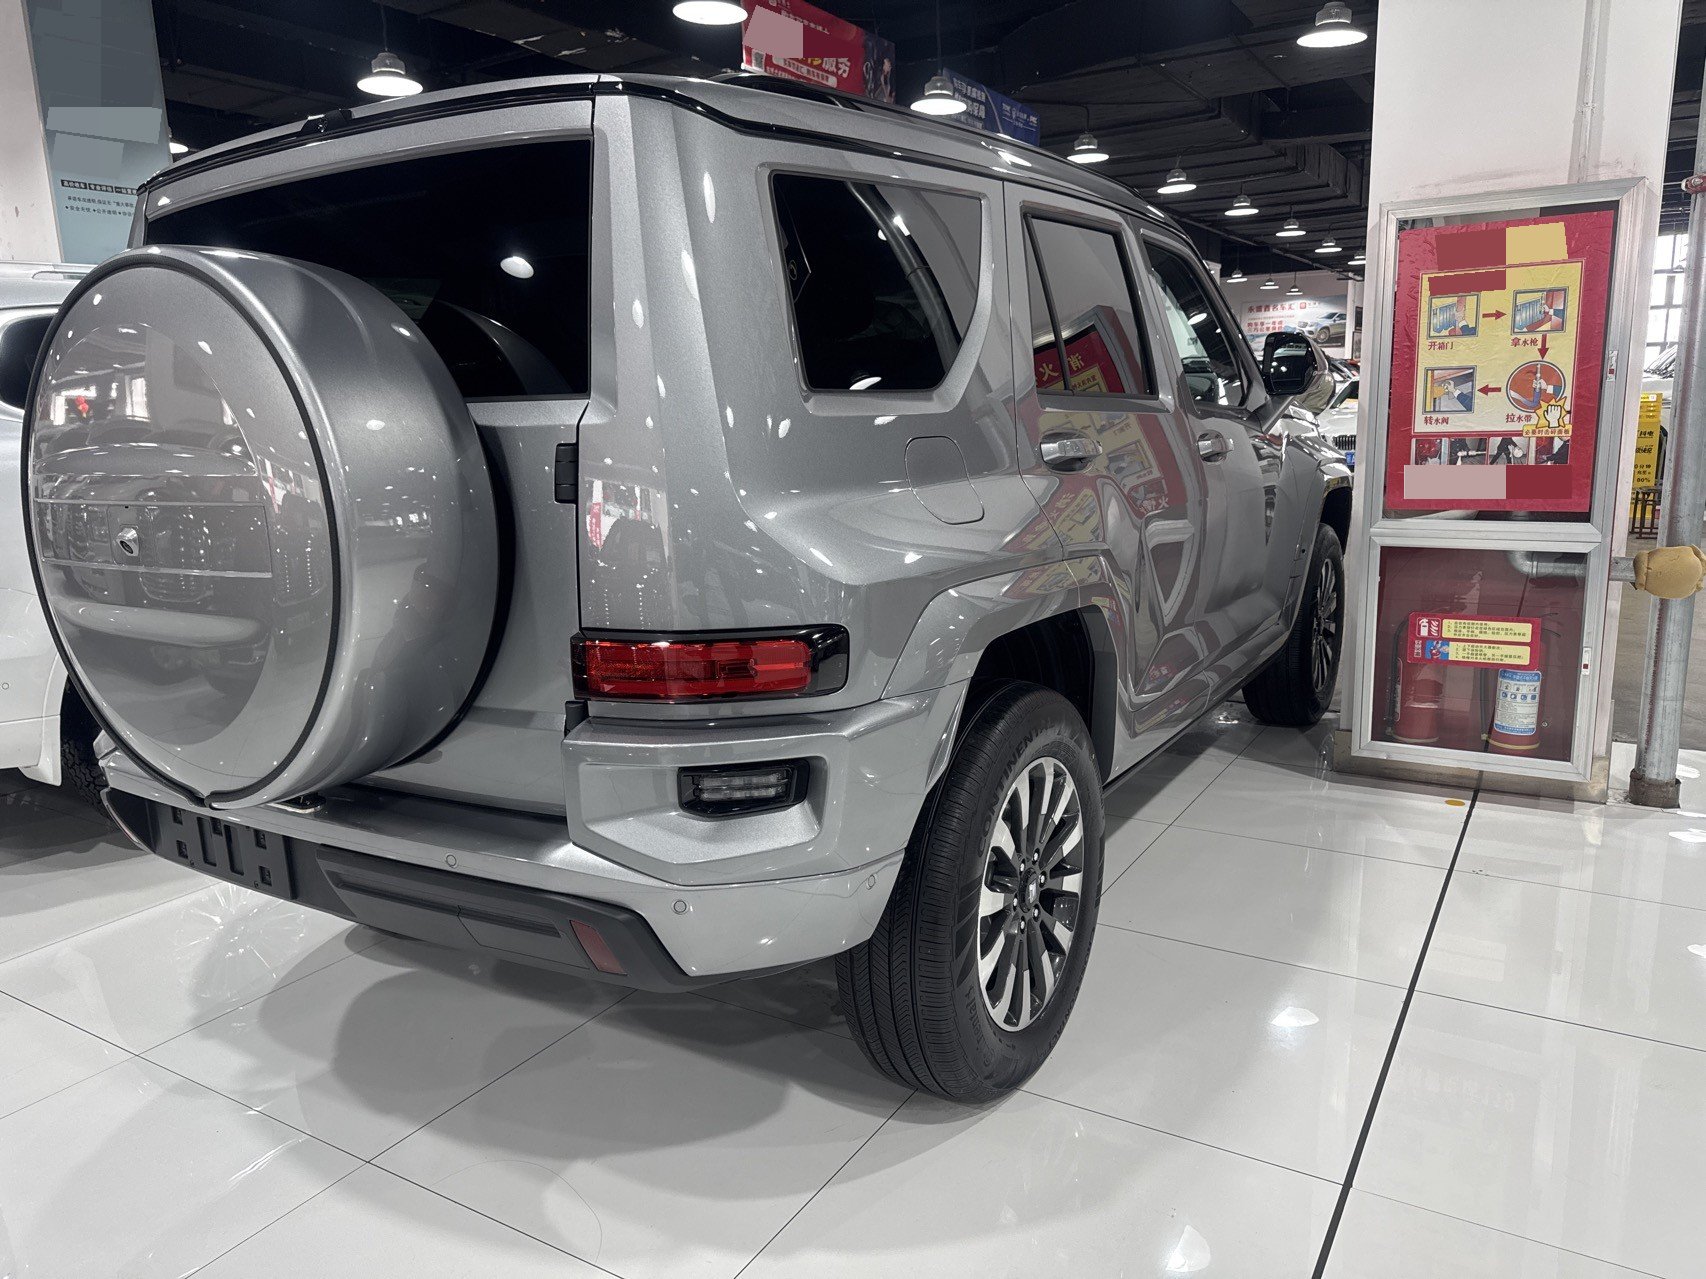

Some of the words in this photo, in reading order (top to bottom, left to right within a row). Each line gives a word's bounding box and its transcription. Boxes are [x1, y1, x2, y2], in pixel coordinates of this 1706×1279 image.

[1428, 341, 1454, 351] 开箱门
[1511, 337, 1538, 347] 拿水枪
[1424, 416, 1449, 425] 转水阀
[1505, 413, 1533, 423] 拉水带
